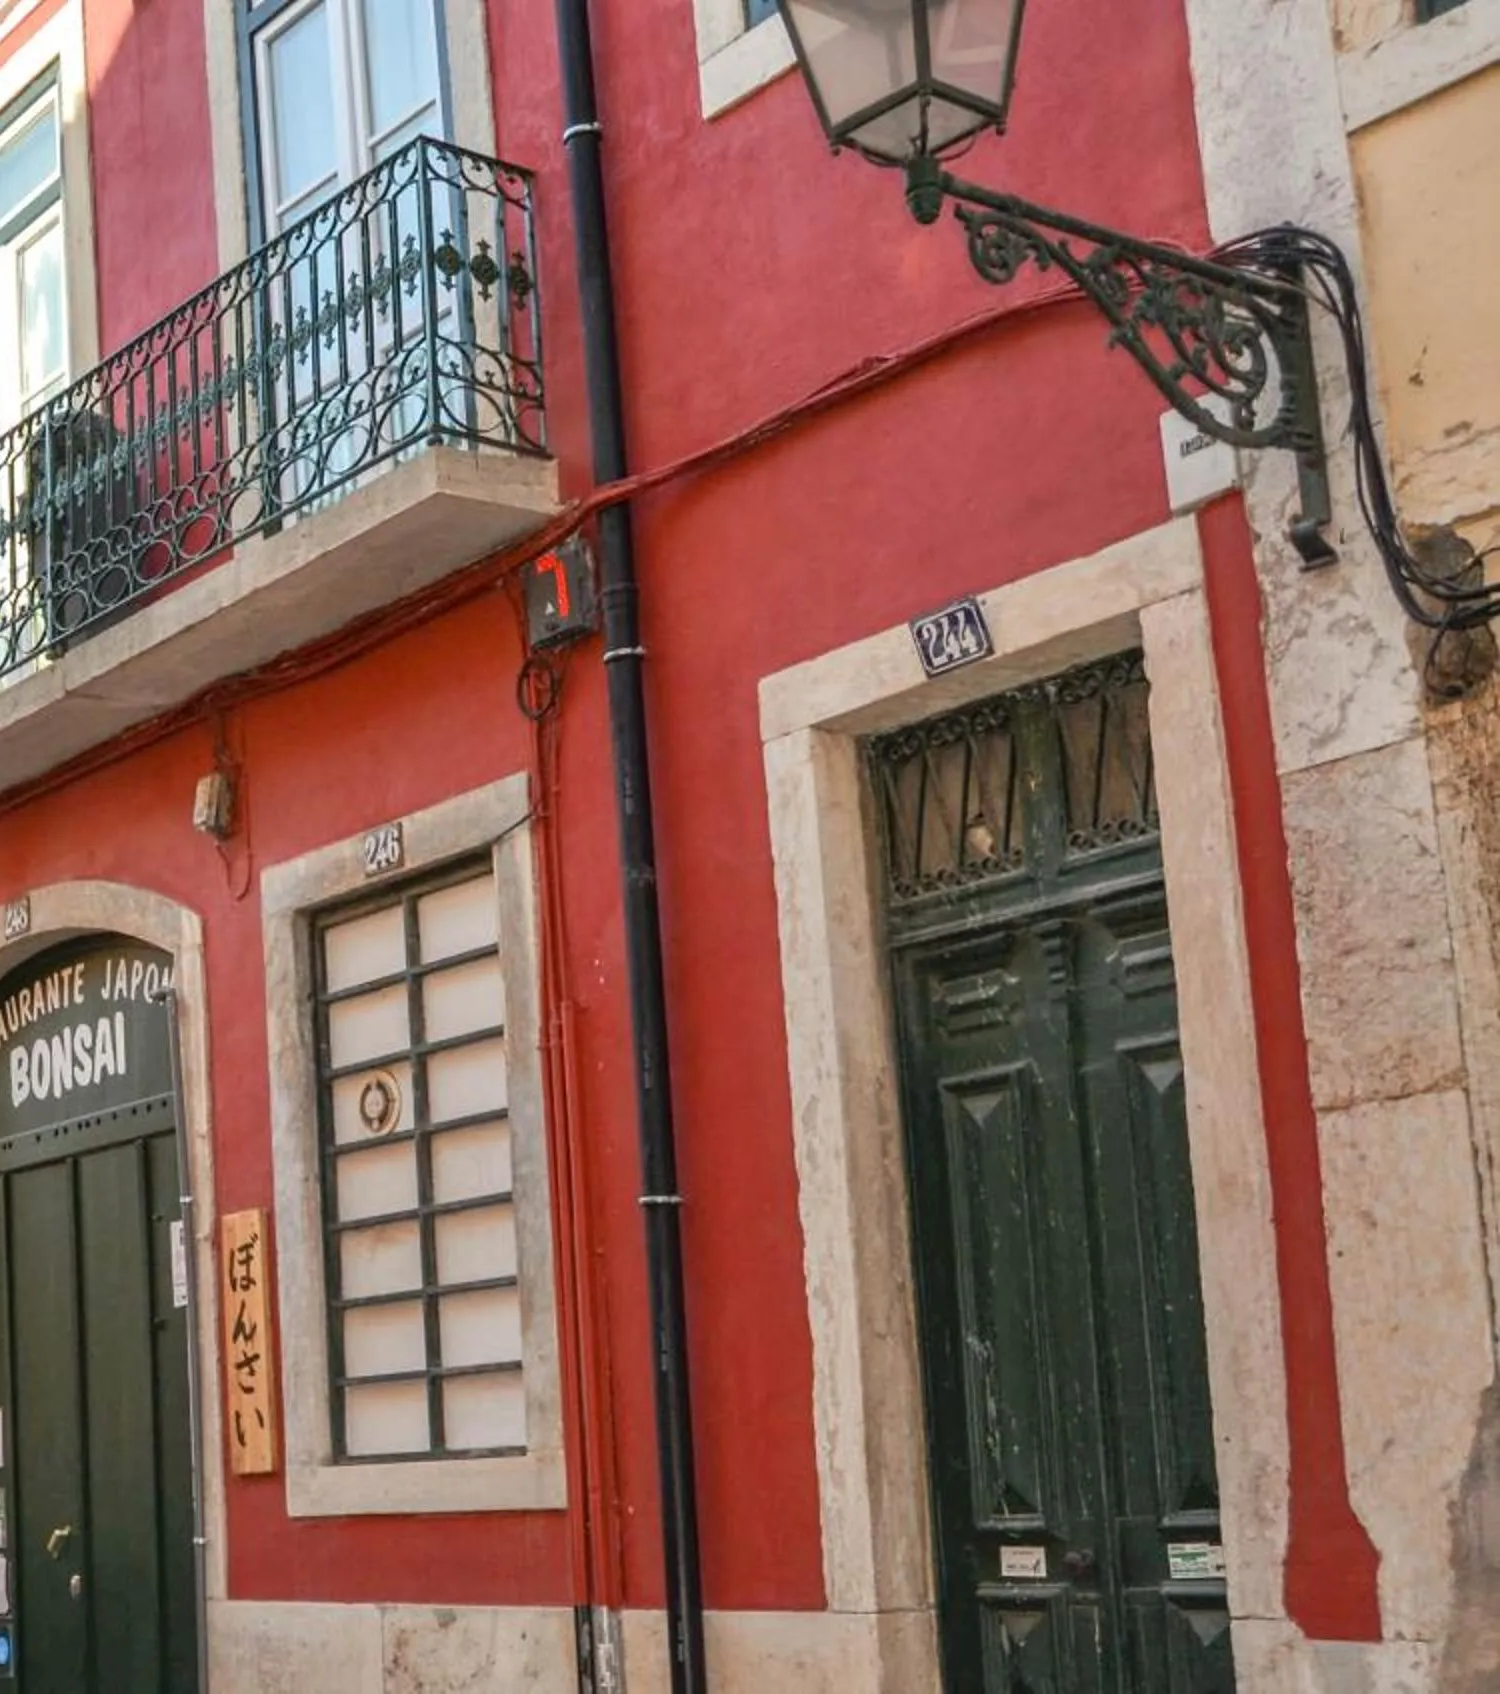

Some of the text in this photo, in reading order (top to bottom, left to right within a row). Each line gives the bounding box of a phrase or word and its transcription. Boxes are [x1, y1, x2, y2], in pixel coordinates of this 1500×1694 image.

[922, 609, 979, 667] 244
[365, 828, 399, 871] 246
[10, 1011, 126, 1108] BONSAI
